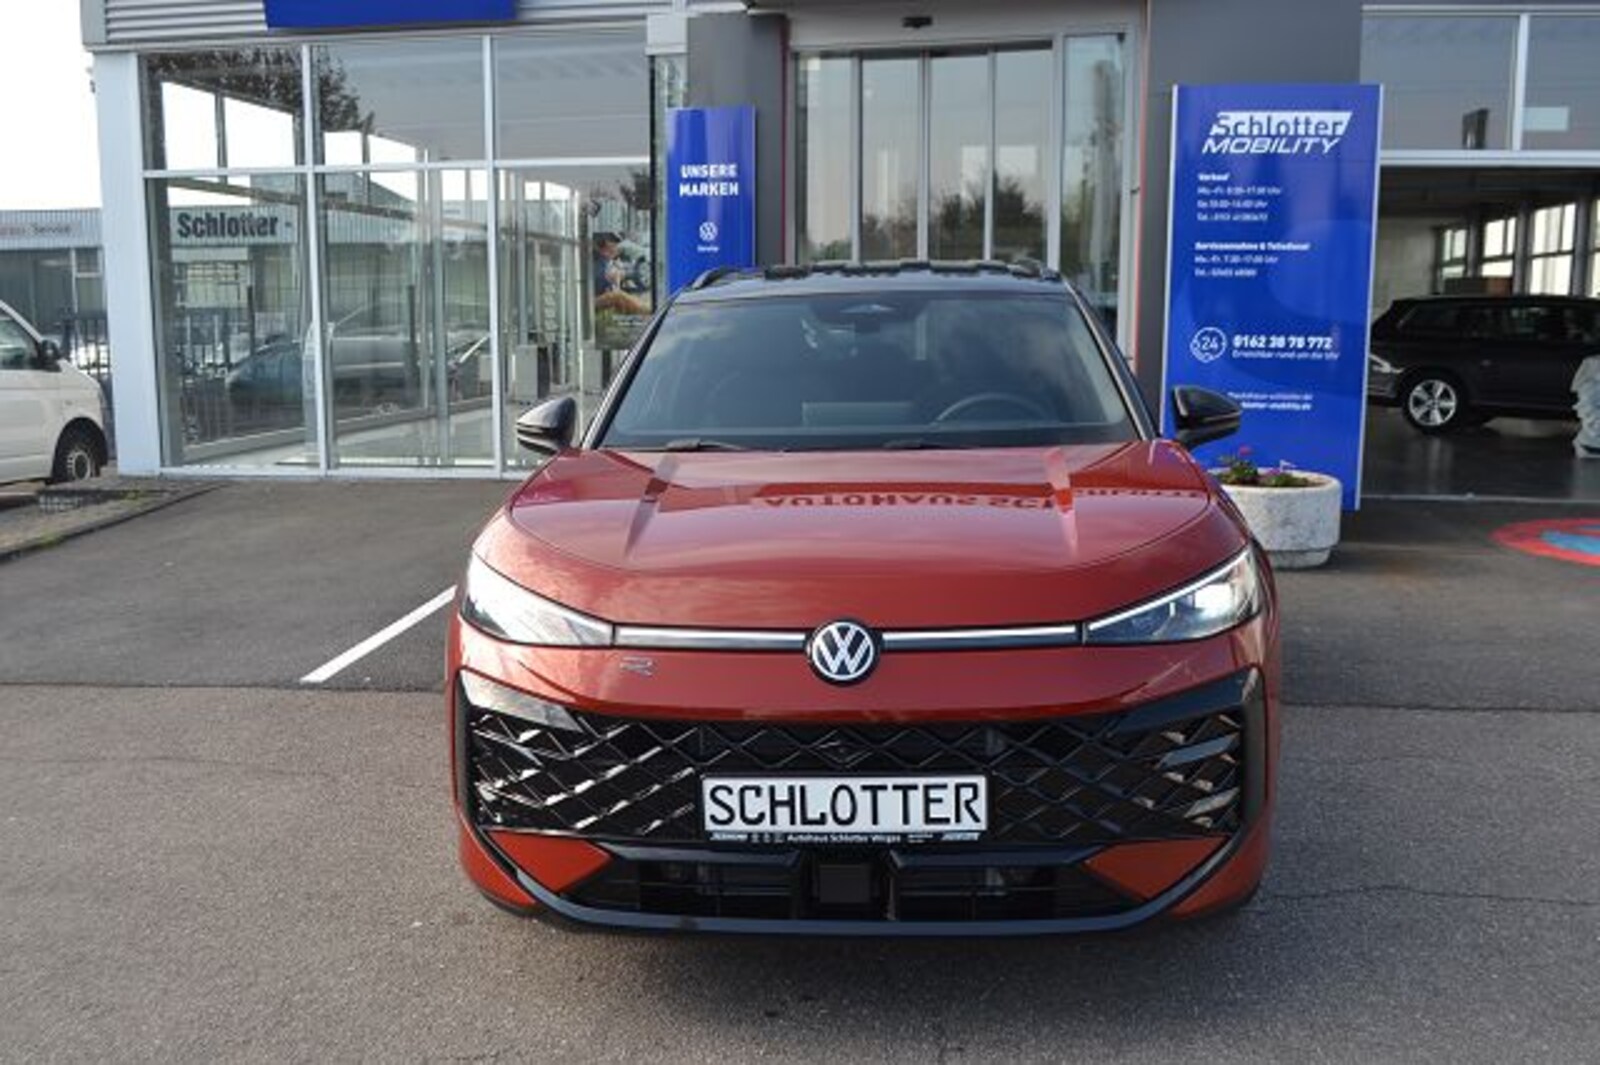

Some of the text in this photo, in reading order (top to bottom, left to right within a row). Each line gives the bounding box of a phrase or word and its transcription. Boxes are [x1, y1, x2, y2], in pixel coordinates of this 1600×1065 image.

[1211, 112, 1348, 136] Schlotter
[1202, 137, 1340, 154] MOBILITY
[681, 164, 737, 178] UNSERE
[680, 182, 739, 196] MARKEN
[177, 212, 278, 239] Schlotter
[1201, 336, 1219, 350] 24
[1232, 334, 1266, 348] 0162
[1307, 336, 1333, 350] 772
[708, 783, 982, 826] SCHLOTTER
